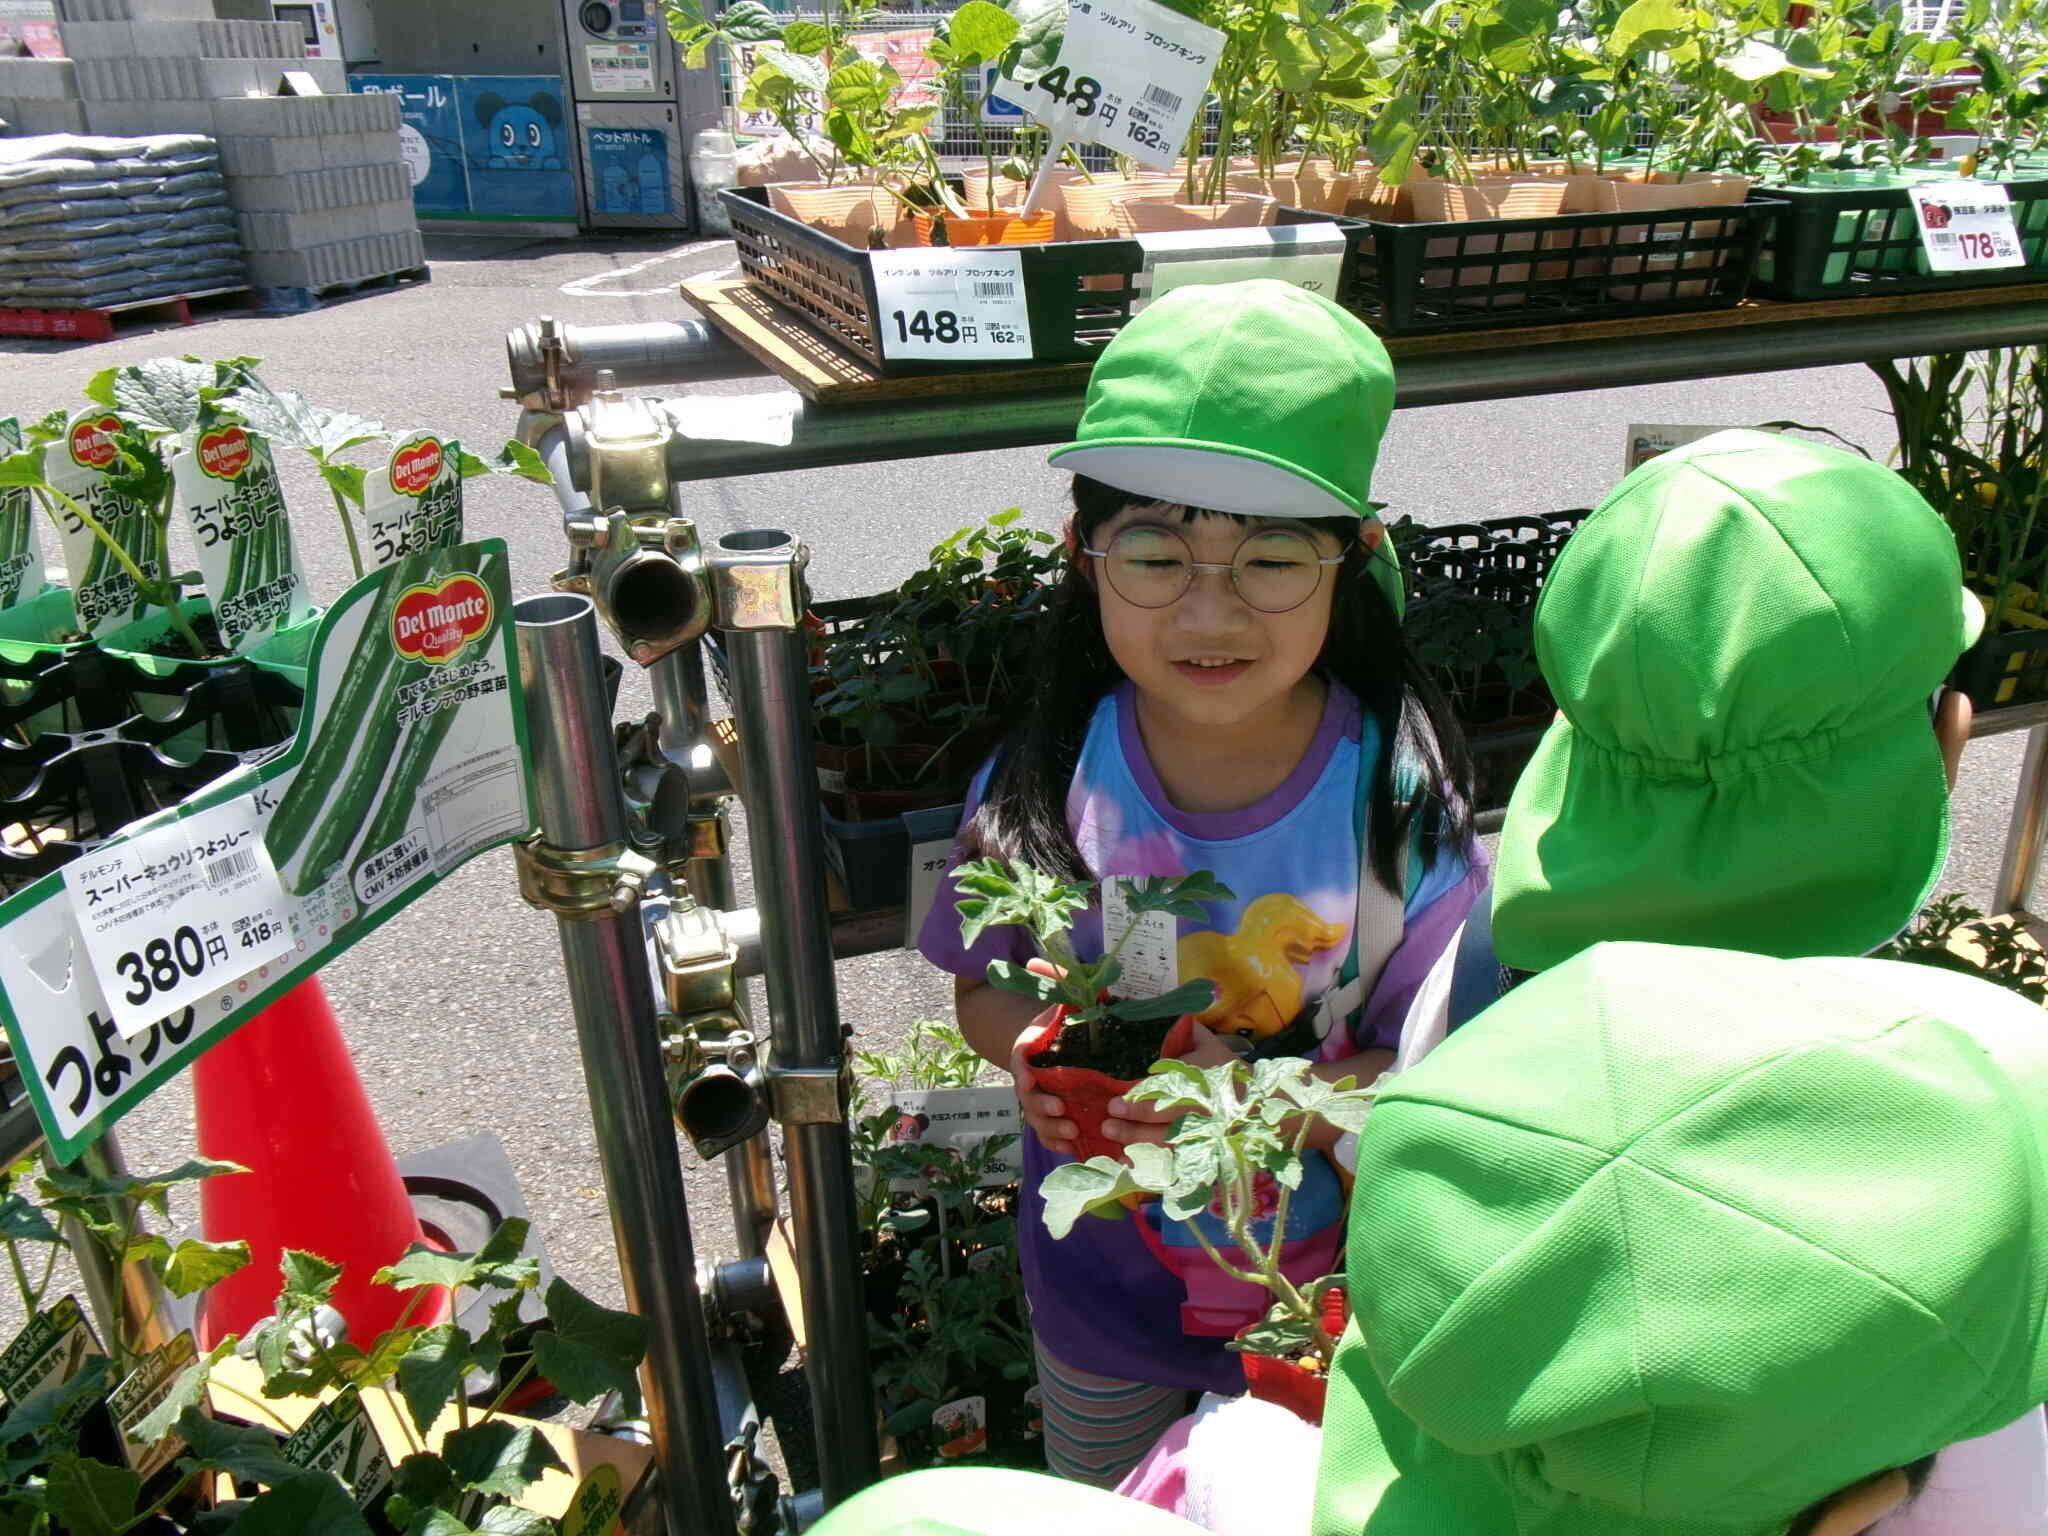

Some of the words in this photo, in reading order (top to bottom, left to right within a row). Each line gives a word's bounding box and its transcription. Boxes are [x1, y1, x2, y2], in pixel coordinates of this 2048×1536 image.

[1024, 65, 1103, 117] 48
[1099, 102, 1119, 128] 円
[592, 131, 653, 144] ペットボトル
[1127, 121, 1161, 149] 162
[1959, 233, 1995, 259] 178
[892, 309, 960, 344] 148
[961, 326, 978, 344] 円
[990, 331, 1016, 344] 162
[190, 472, 280, 525] スーパーキュウリ
[371, 486, 460, 541] スーパーキュウリ
[197, 503, 281, 548] つよっしー
[374, 516, 457, 565] つよっしー
[397, 610, 428, 639] Del
[426, 596, 485, 630] Monte
[423, 627, 463, 649] Quality
[398, 675, 508, 724] デルモンテの野菜苗
[79, 859, 123, 885] デルモンテ
[85, 829, 250, 906] スーパーキュウリつよっしー
[364, 878, 386, 900] CMV
[241, 921, 272, 949] 418
[271, 920, 284, 935] 円
[116, 925, 206, 1007] 380
[205, 934, 229, 967] 円
